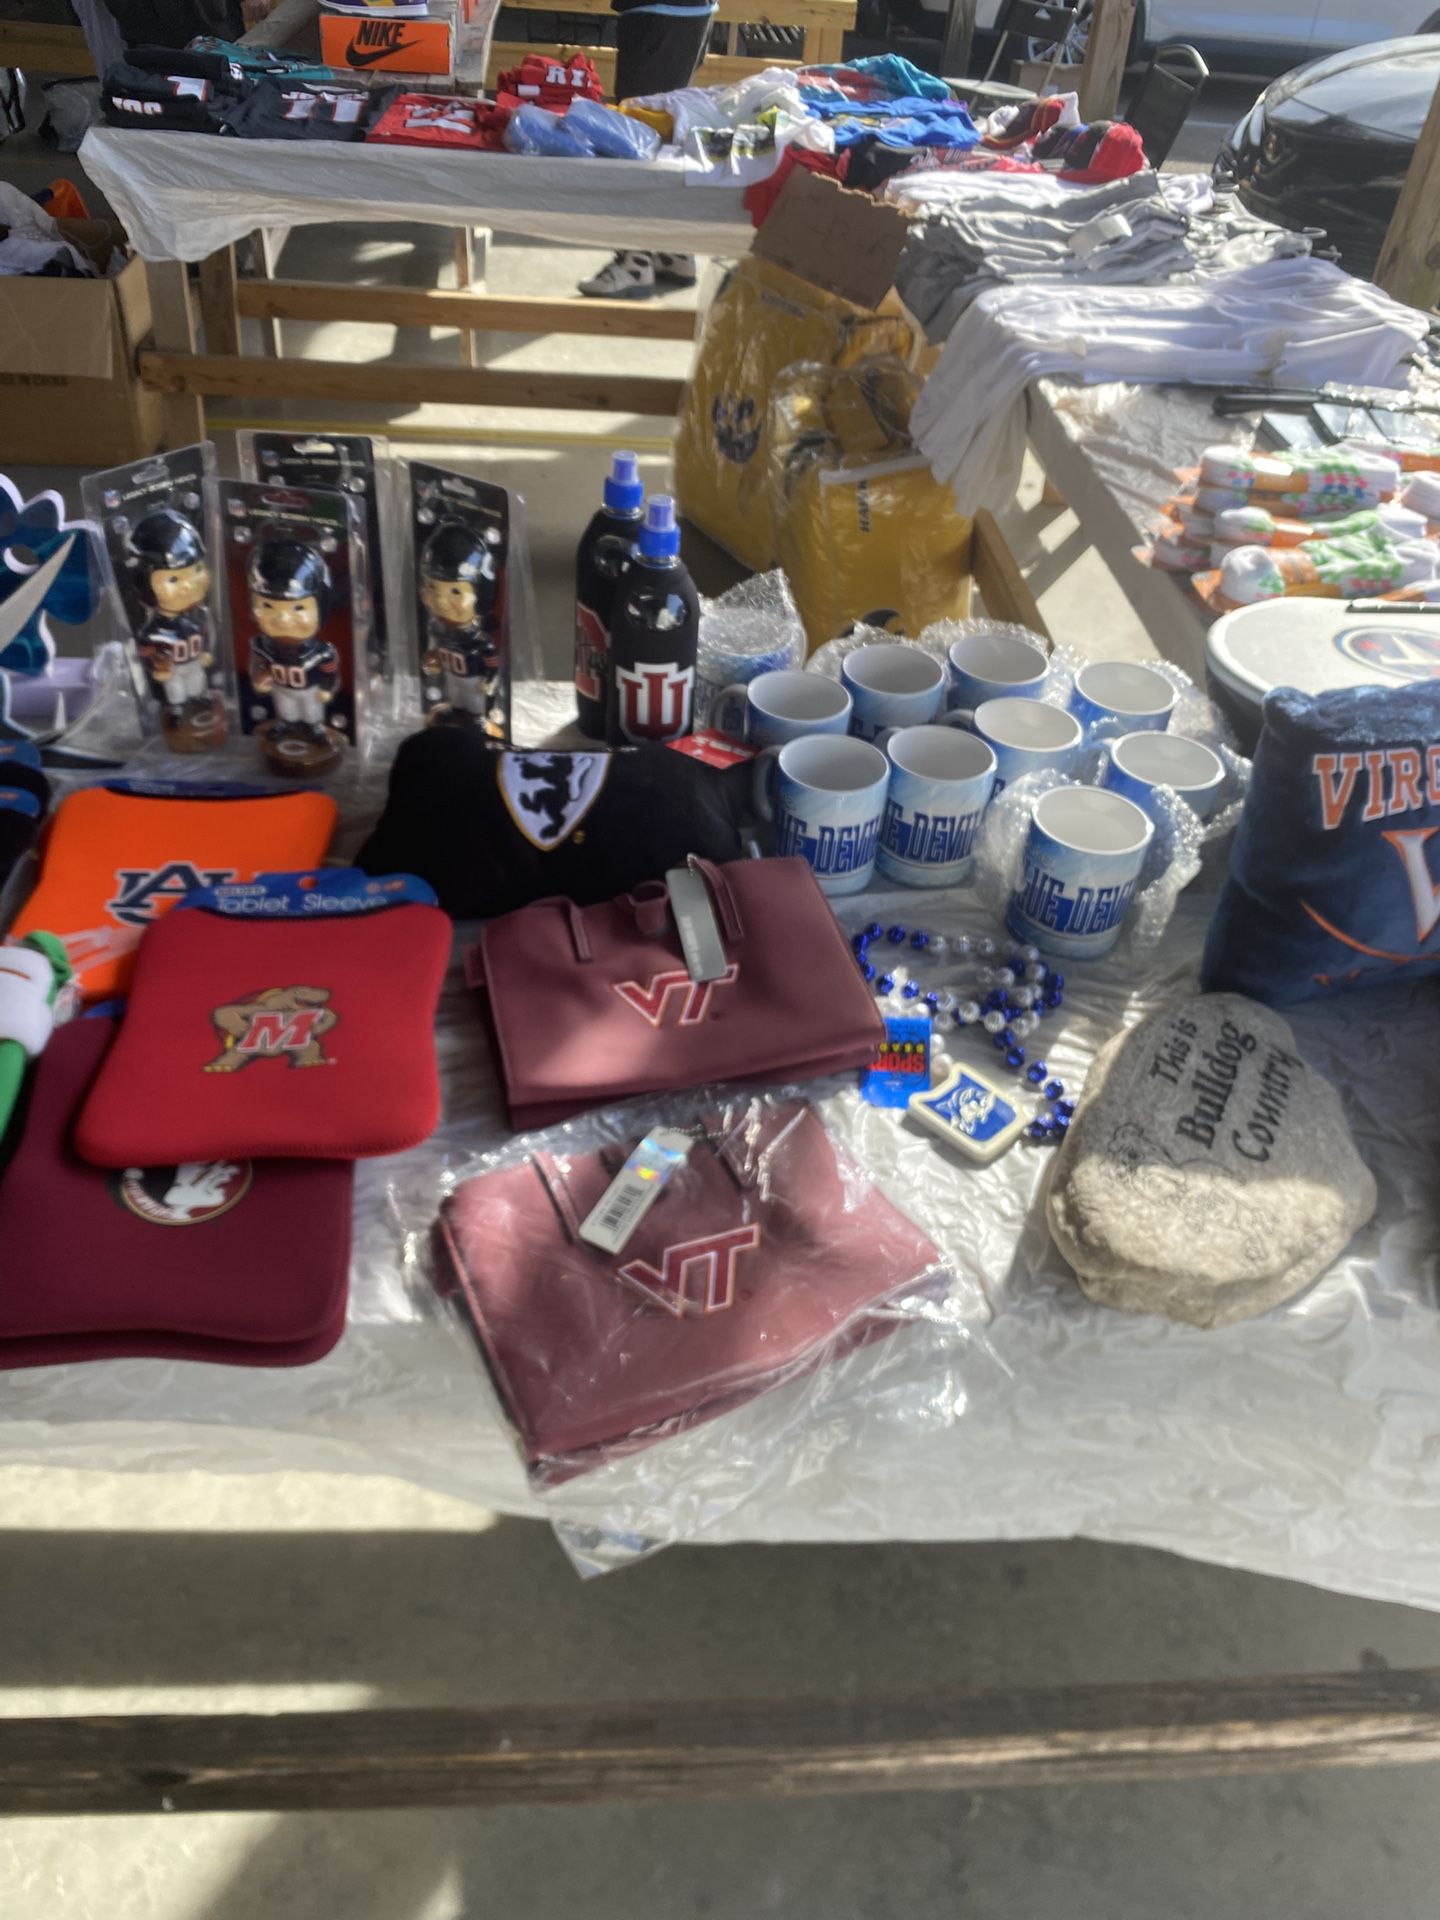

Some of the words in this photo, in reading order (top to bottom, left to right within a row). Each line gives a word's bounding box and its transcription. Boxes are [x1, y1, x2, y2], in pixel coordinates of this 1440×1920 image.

[356, 20, 406, 48] NIKE
[217, 894, 290, 914] Tablet
[612, 962, 740, 1028] VT
[237, 1008, 325, 1053] M
[1170, 1018, 1198, 1039] is
[1150, 1037, 1192, 1085] This
[1174, 1020, 1257, 1150] Bulldog
[1232, 1043, 1305, 1162] Country
[618, 1222, 761, 1318] VT
